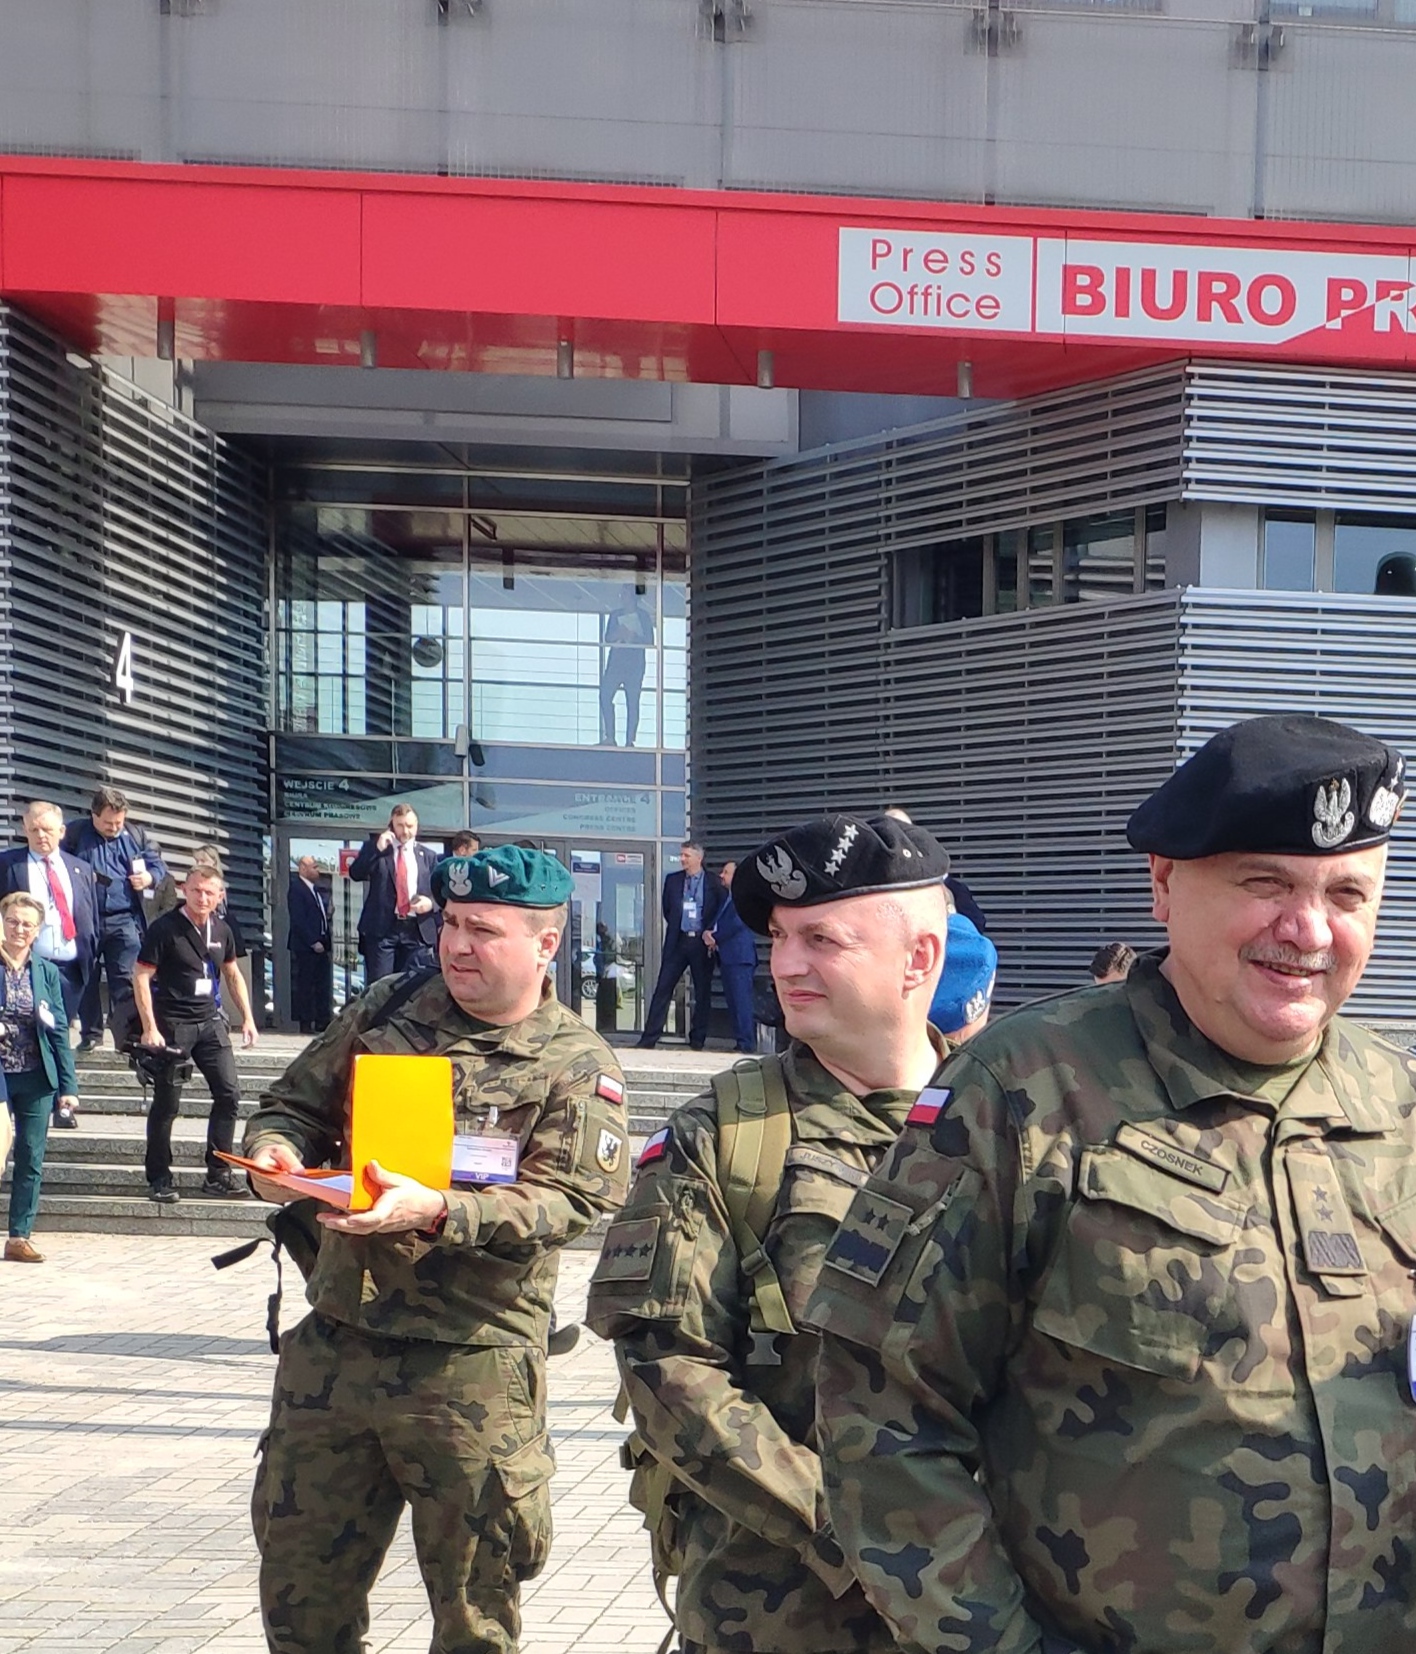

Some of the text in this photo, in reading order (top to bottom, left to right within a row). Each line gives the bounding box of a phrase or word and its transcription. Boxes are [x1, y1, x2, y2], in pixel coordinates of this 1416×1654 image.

[870, 238, 1002, 278] Press
[868, 280, 1002, 320] Office
[1060, 262, 1298, 328] BIURO
[116, 630, 134, 704] 4
[339, 779, 349, 791] 4
[474, 1172, 490, 1180] VIP
[1141, 1140, 1204, 1176] CZOSNEK
